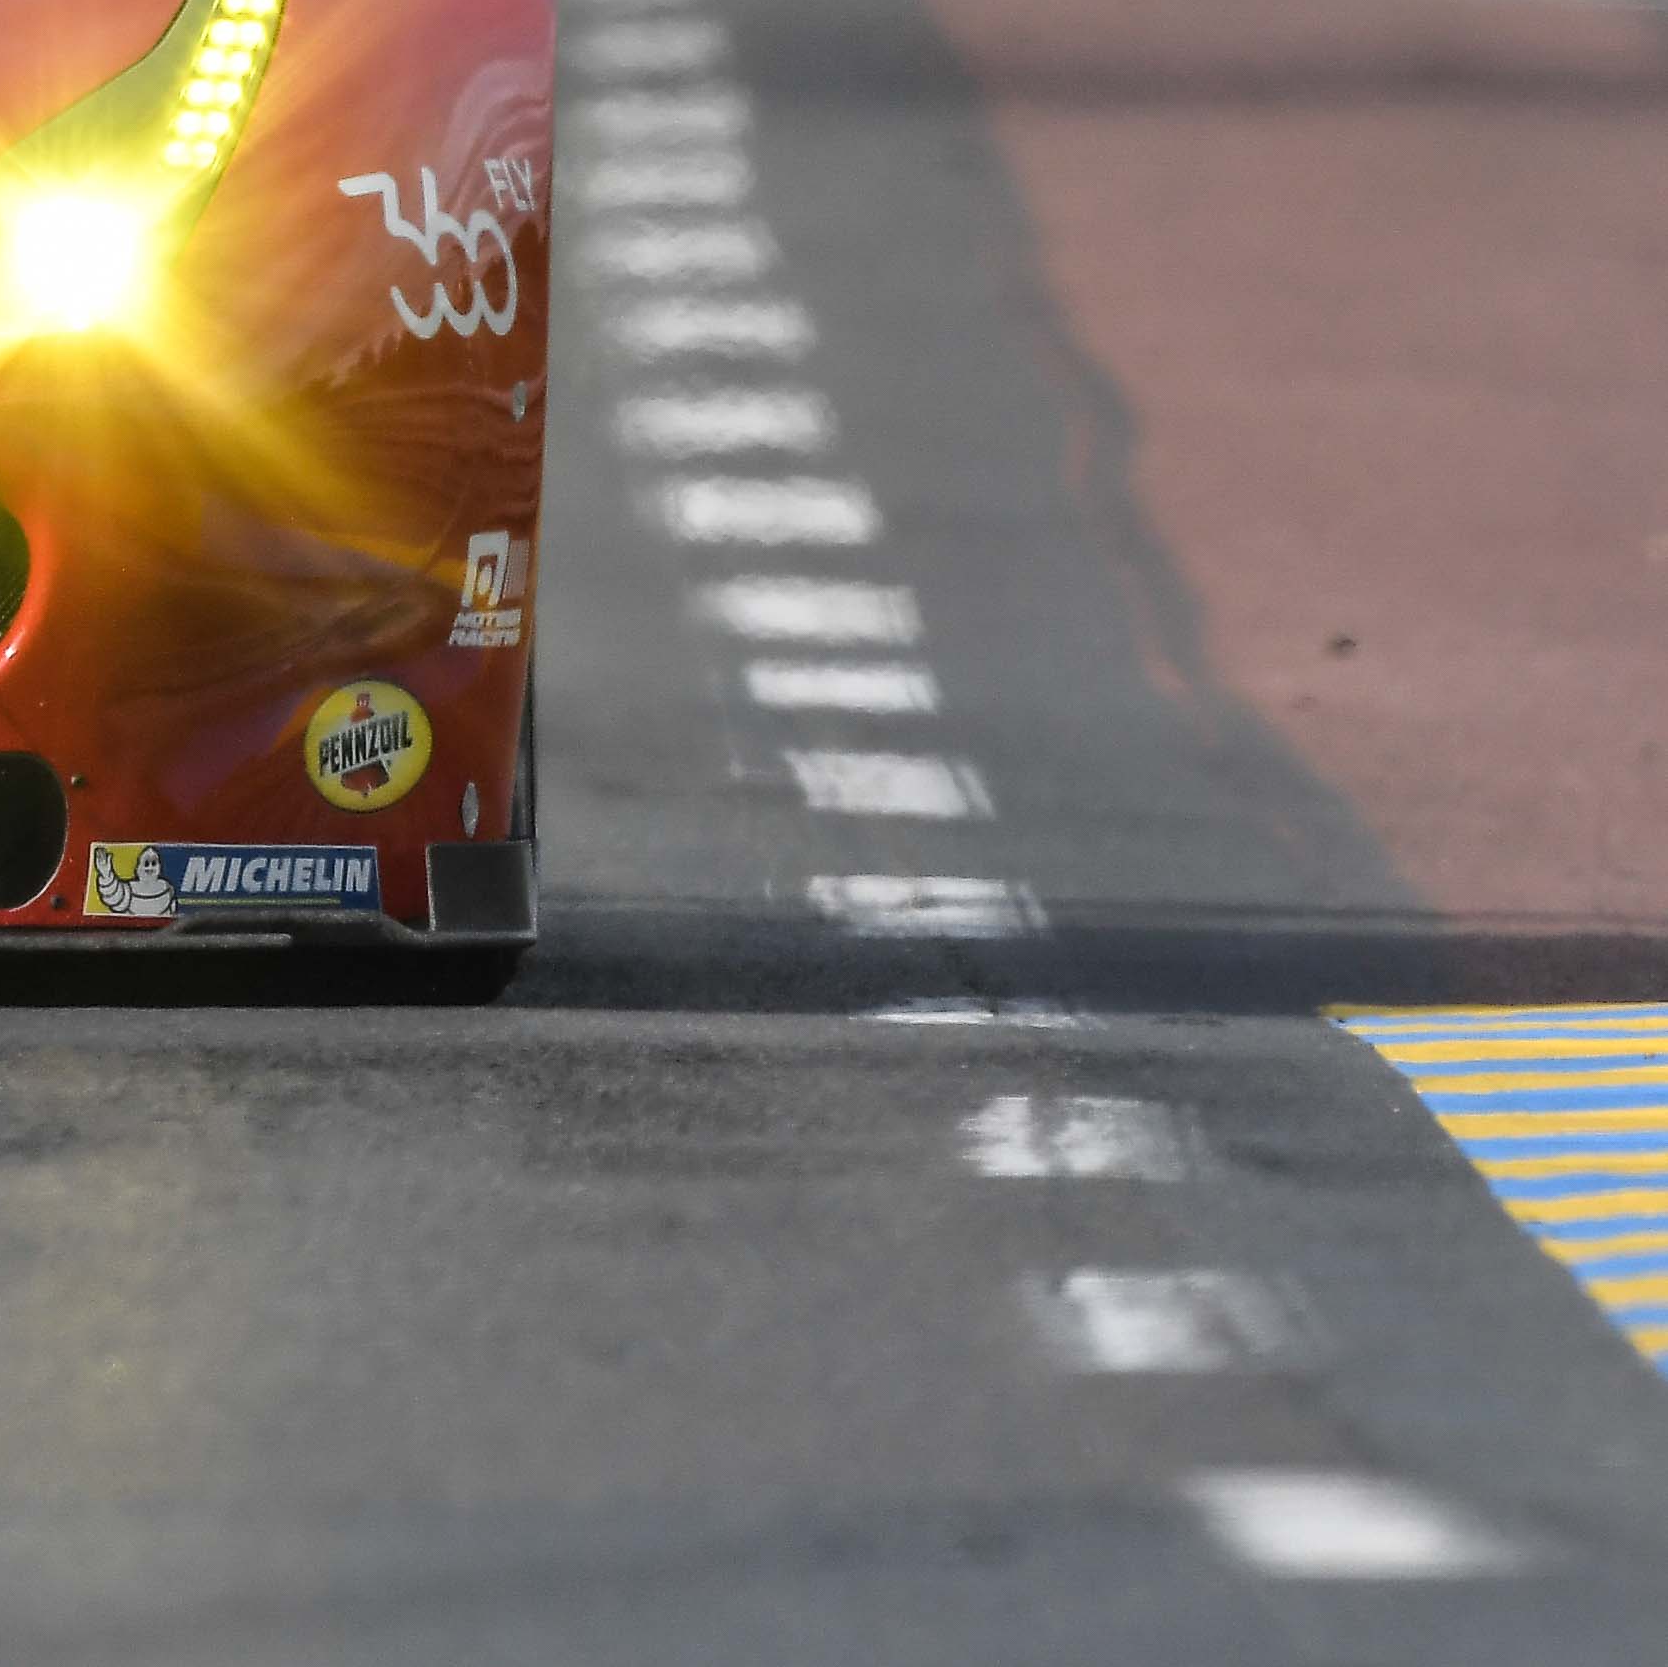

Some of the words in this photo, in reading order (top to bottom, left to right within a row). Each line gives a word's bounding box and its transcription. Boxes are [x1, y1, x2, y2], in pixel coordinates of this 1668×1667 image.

[484, 156, 537, 212] FLY
[319, 711, 413, 777] PENNZOIL
[180, 856, 371, 893] MICHELIN
